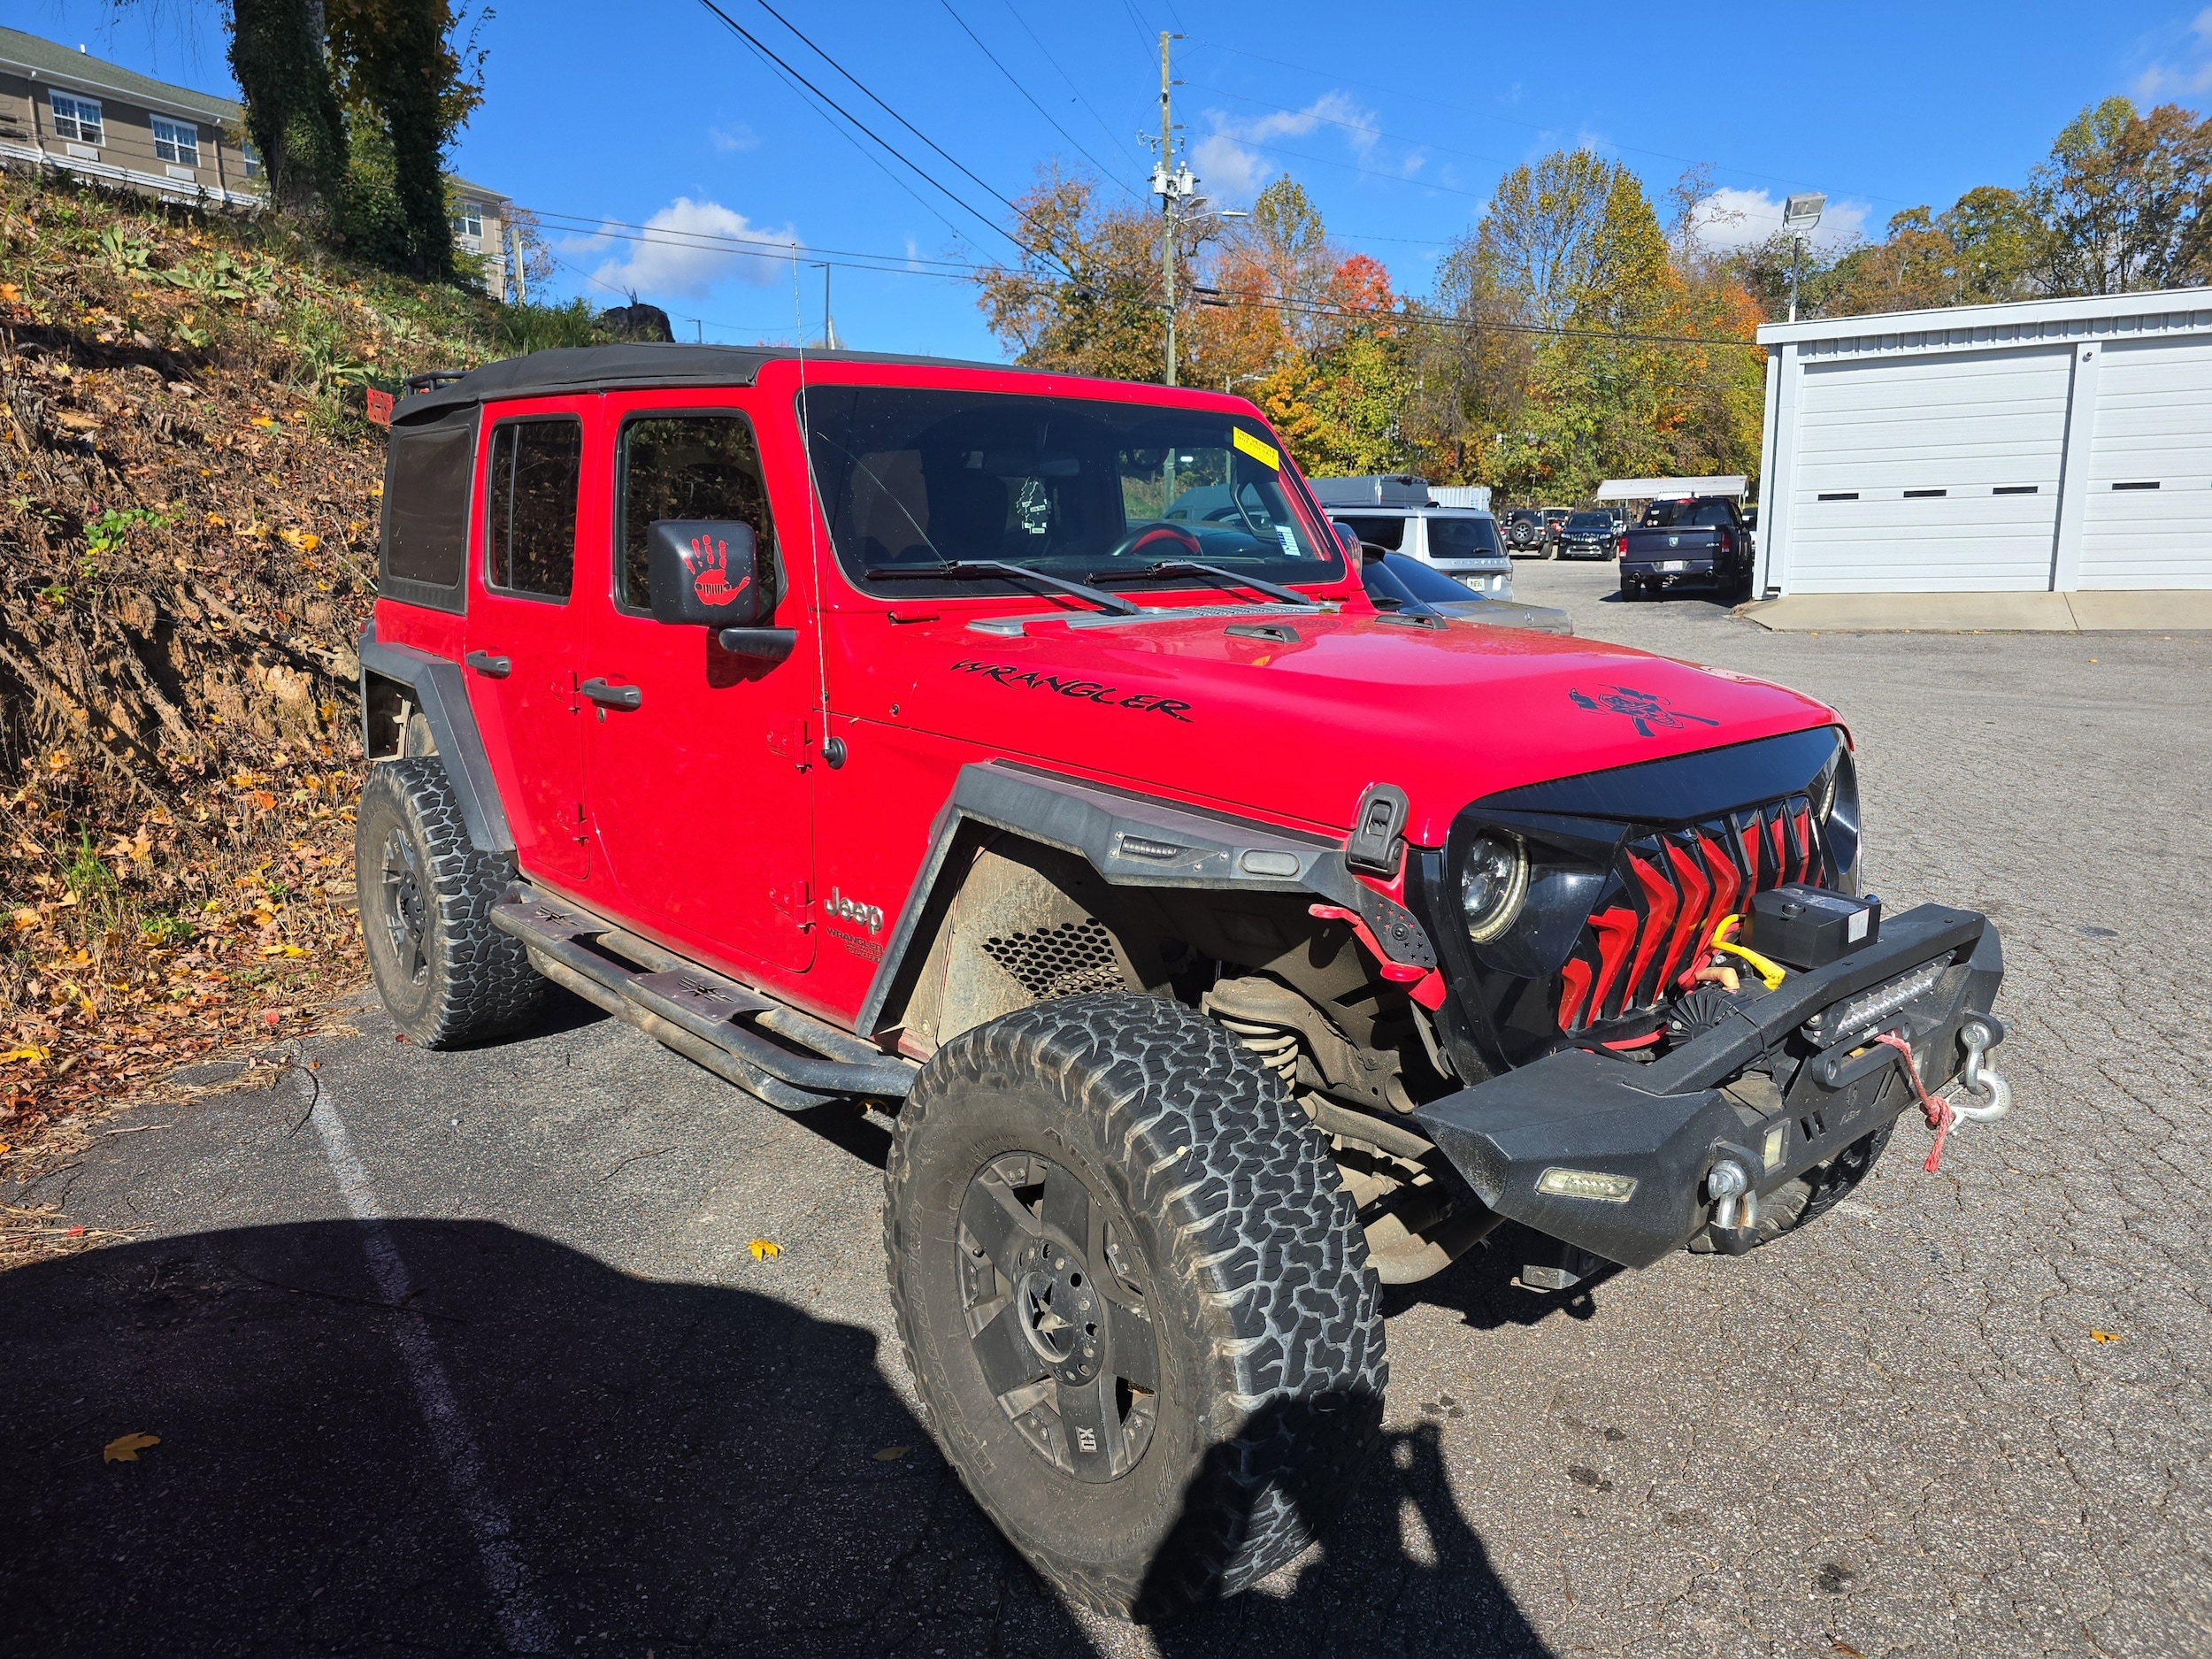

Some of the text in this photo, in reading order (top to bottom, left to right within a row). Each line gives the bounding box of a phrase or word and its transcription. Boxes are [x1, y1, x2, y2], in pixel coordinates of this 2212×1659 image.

[950, 658, 1194, 723] WRANGLER
[824, 886, 884, 936] Jeep
[826, 926, 883, 952] WRANGLER
